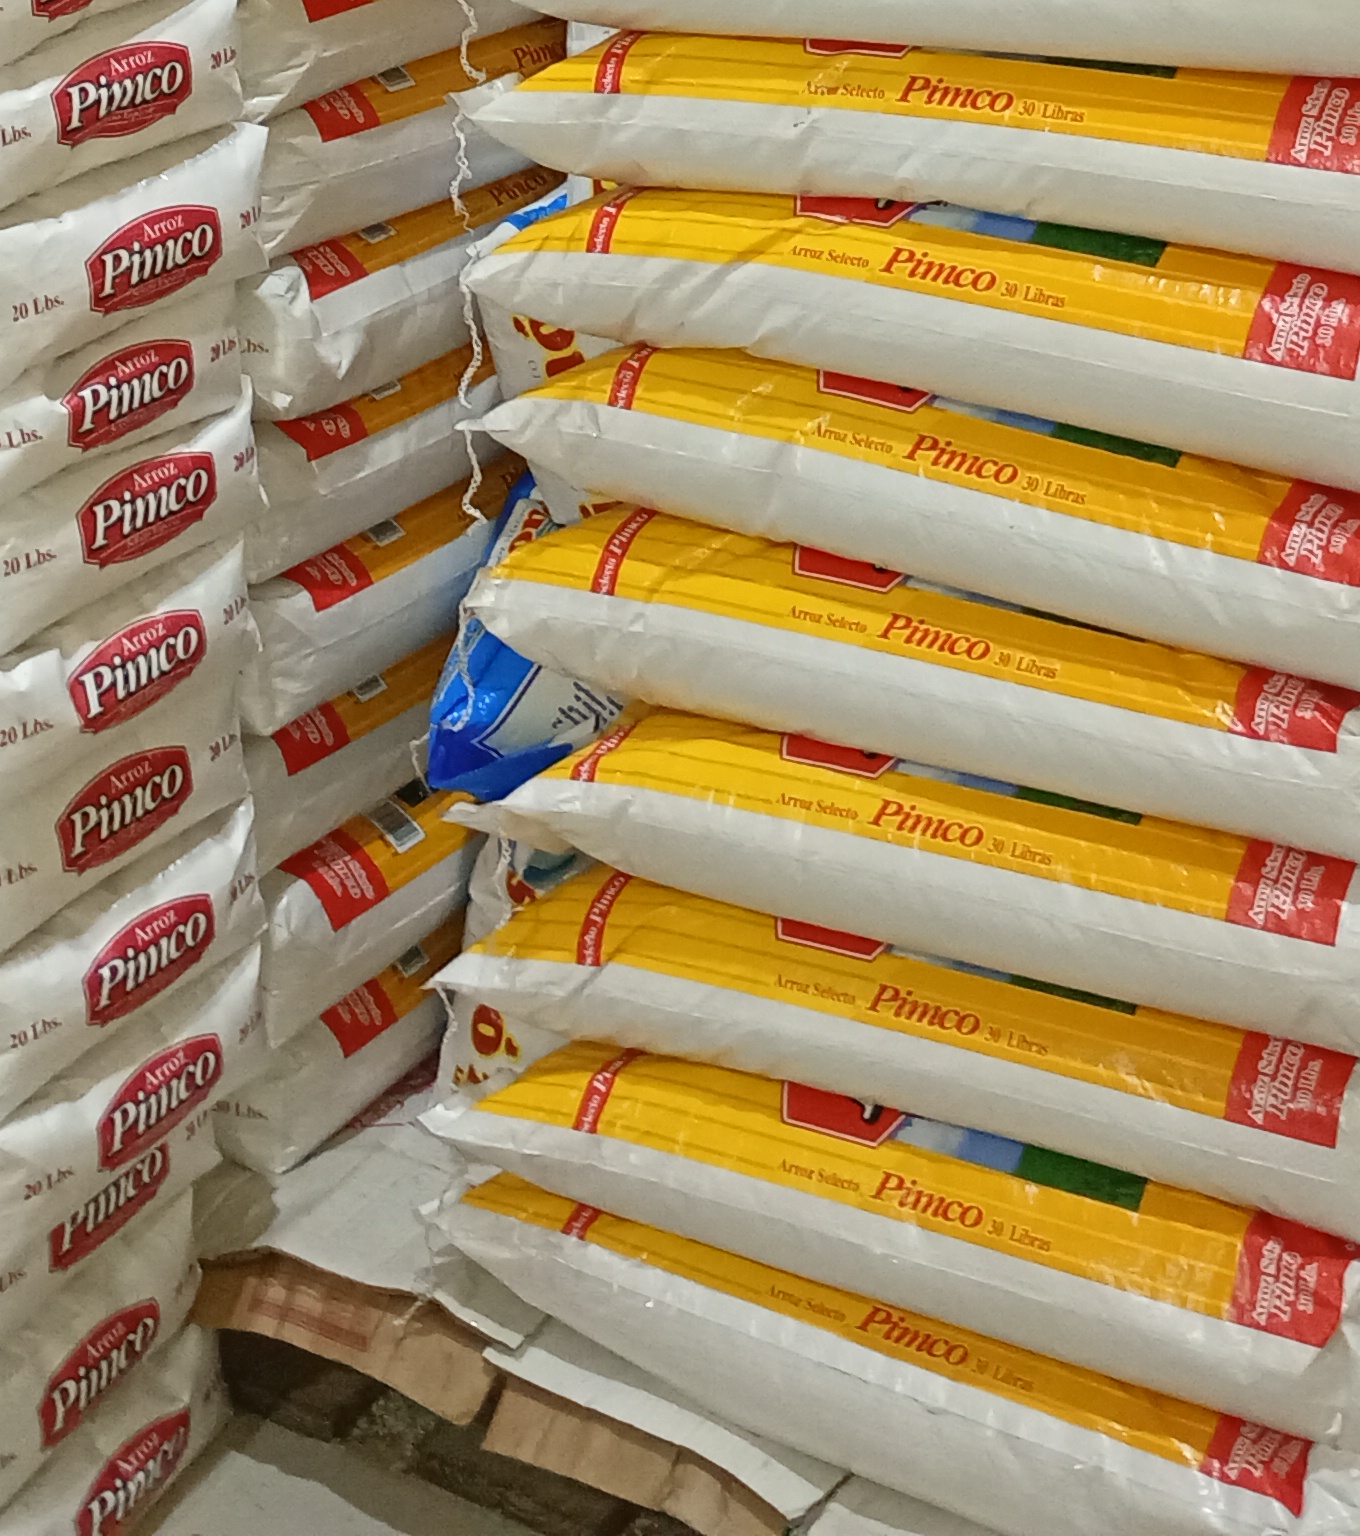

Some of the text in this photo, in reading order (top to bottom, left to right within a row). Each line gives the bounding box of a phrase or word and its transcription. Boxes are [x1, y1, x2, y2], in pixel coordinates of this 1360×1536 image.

[109, 48, 155, 76] Arroz
[0, 125, 32, 147] Lbs.
[66, 60, 183, 131] Pimco
[896, 74, 1014, 114] Pimco
[142, 213, 184, 242] Arroz
[12, 224, 213, 322] 20 Lbs. Pimco
[879, 246, 997, 294] Pimco
[78, 357, 188, 433] Pimco
[902, 433, 1019, 485] Pimco
[91, 469, 209, 550] Pimco
[877, 612, 991, 661] Pimco
[78, 626, 199, 719] Pimco
[69, 765, 184, 858] Pimco
[867, 798, 984, 849] Pimco
[95, 912, 208, 1011] Pimco
[865, 982, 981, 1037] Pimco
[109, 1051, 217, 1157] Pimco
[870, 1170, 983, 1229] Pimco
[856, 1305, 968, 1368] Pimco
